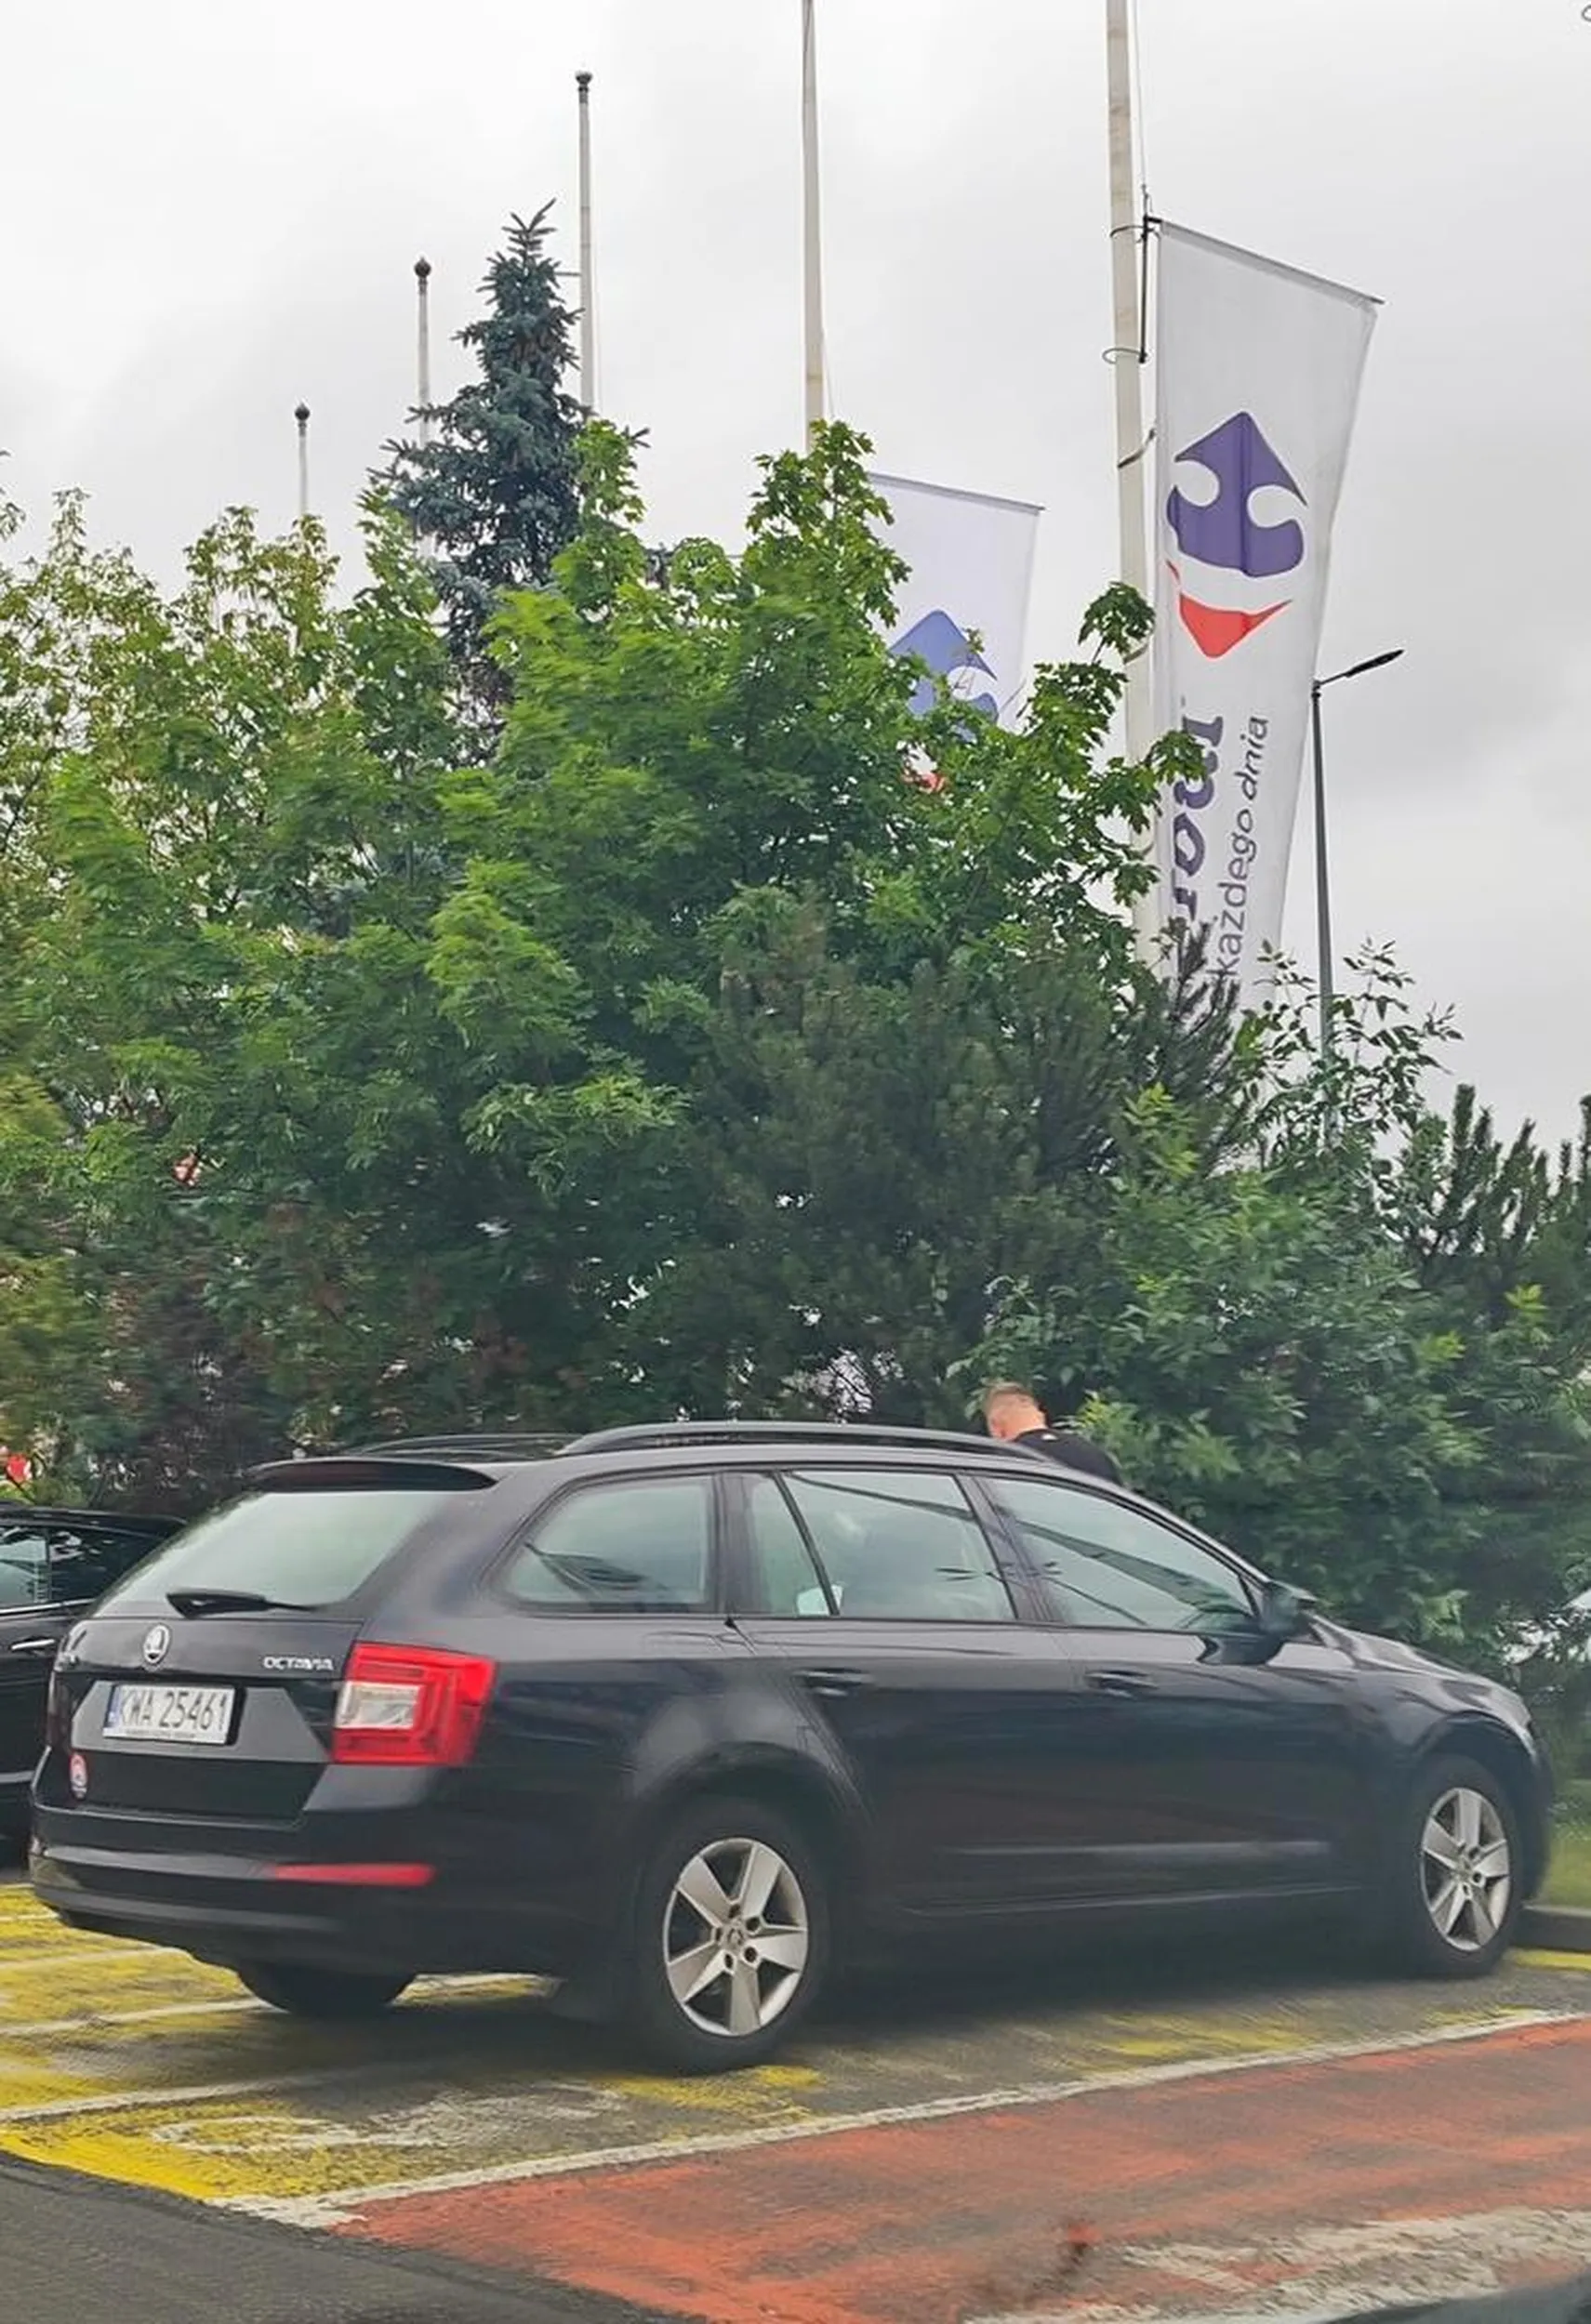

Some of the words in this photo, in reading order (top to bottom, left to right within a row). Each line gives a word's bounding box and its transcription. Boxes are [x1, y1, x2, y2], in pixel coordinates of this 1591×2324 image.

[1234, 716, 1269, 800] dnia
[263, 1656, 334, 1671] OCTAVIA
[158, 1690, 228, 1732] 25461
